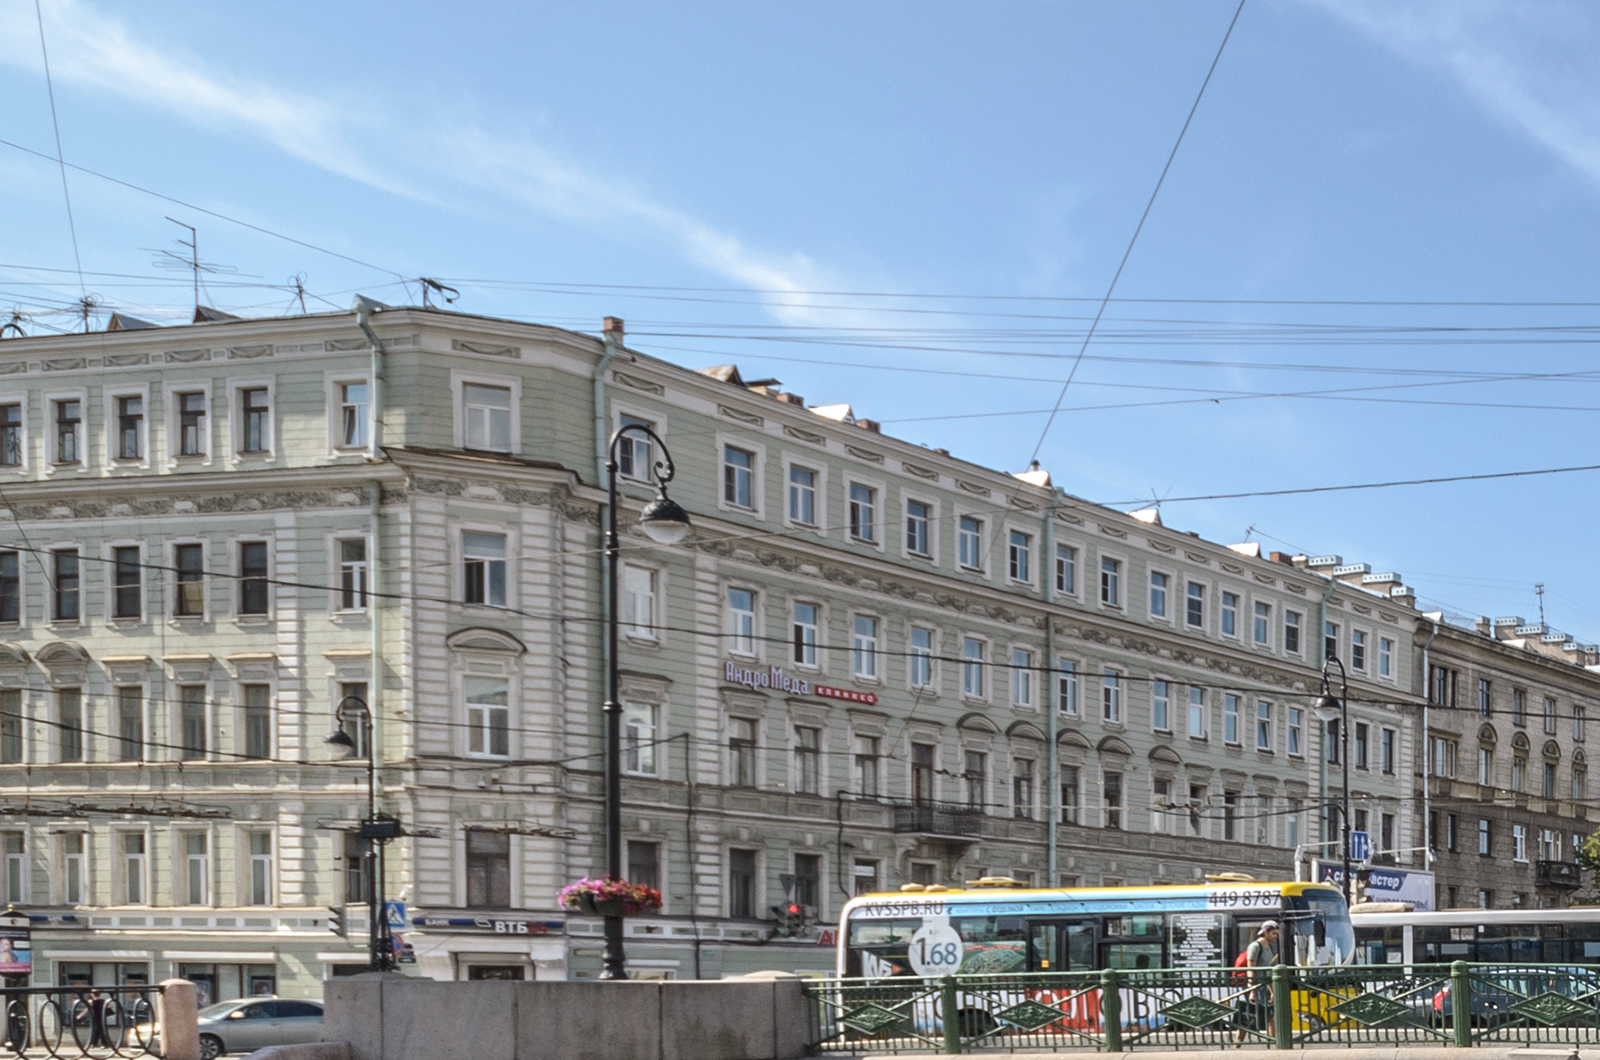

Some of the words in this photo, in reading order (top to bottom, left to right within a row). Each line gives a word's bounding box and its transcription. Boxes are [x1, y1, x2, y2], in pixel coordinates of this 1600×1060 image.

[1209, 891, 1238, 907] 449
[1242, 890, 1282, 907] 8787
[865, 901, 945, 917] KVSSPB.RU
[495, 921, 547, 934] ВТБ24
[916, 937, 957, 965] 1.68
